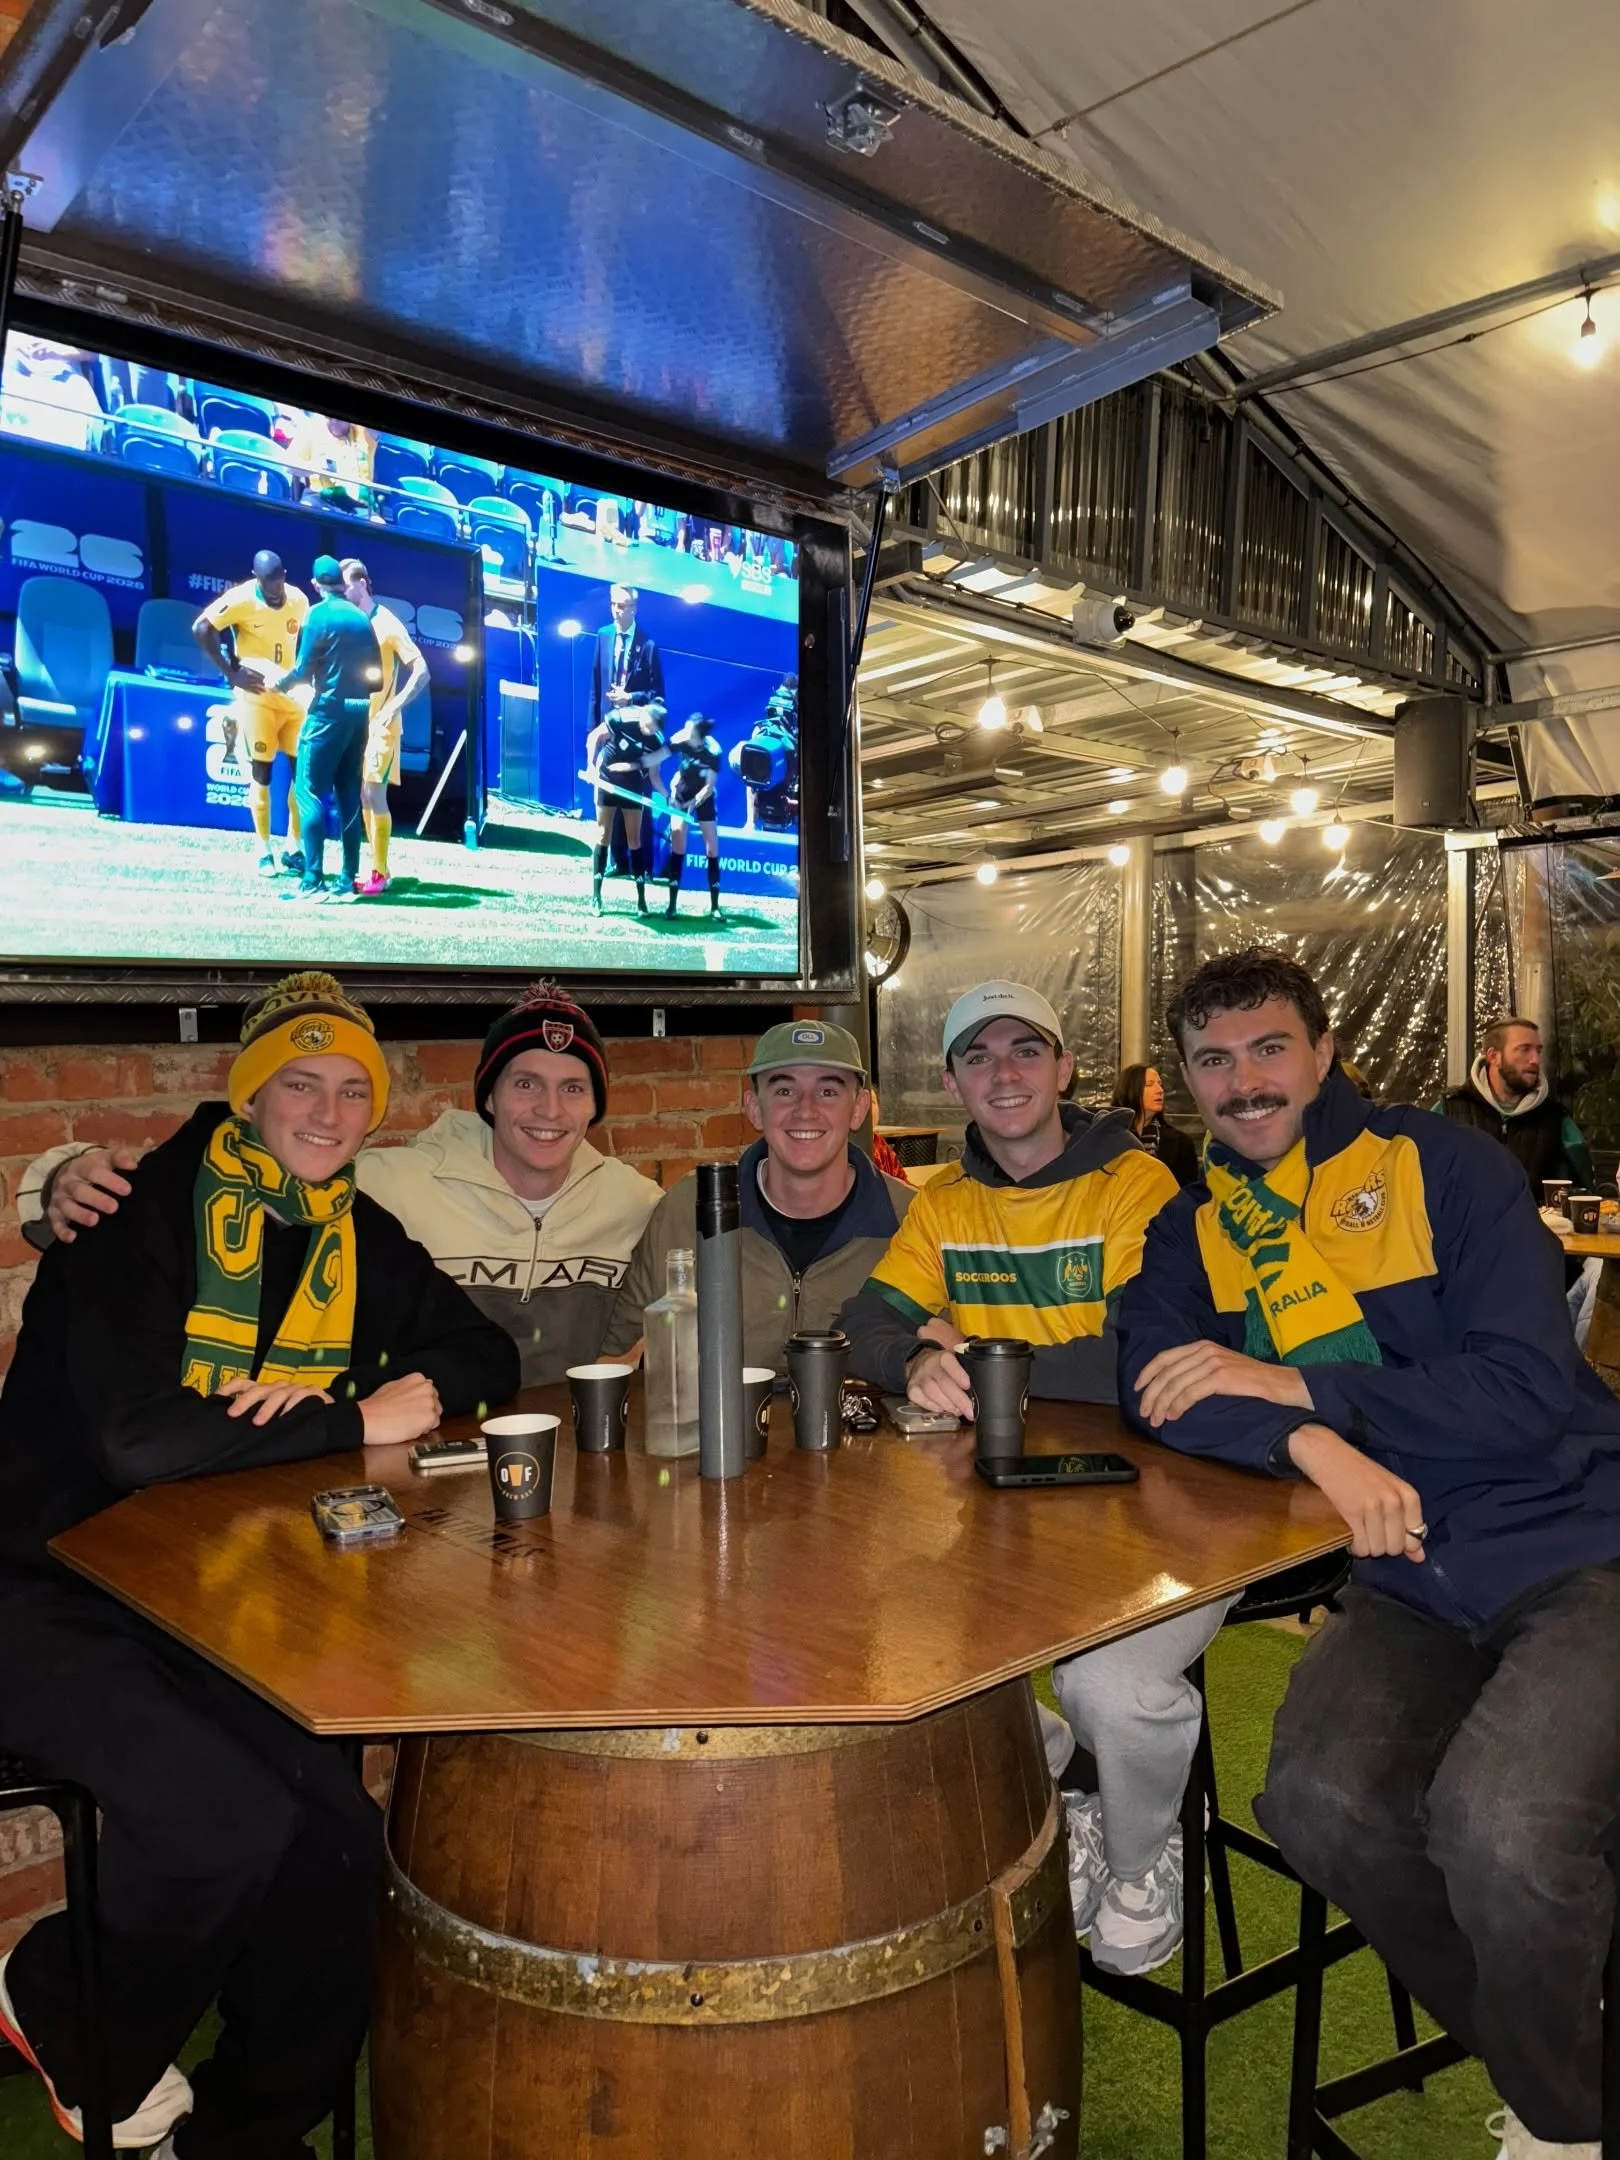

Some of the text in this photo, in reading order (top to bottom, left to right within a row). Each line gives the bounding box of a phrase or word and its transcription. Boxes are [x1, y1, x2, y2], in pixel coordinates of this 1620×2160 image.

[12, 558, 37, 569] FIFA
[38, 562, 80, 577] WORLD
[82, 572, 104, 582] CUP
[742, 561, 772, 584] SBS
[274, 642, 282, 664] 6
[221, 767, 241, 776] FIFA
[206, 783, 237, 793] WORLD
[719, 857, 761, 873] WORLD
[763, 862, 788, 876] CUP
